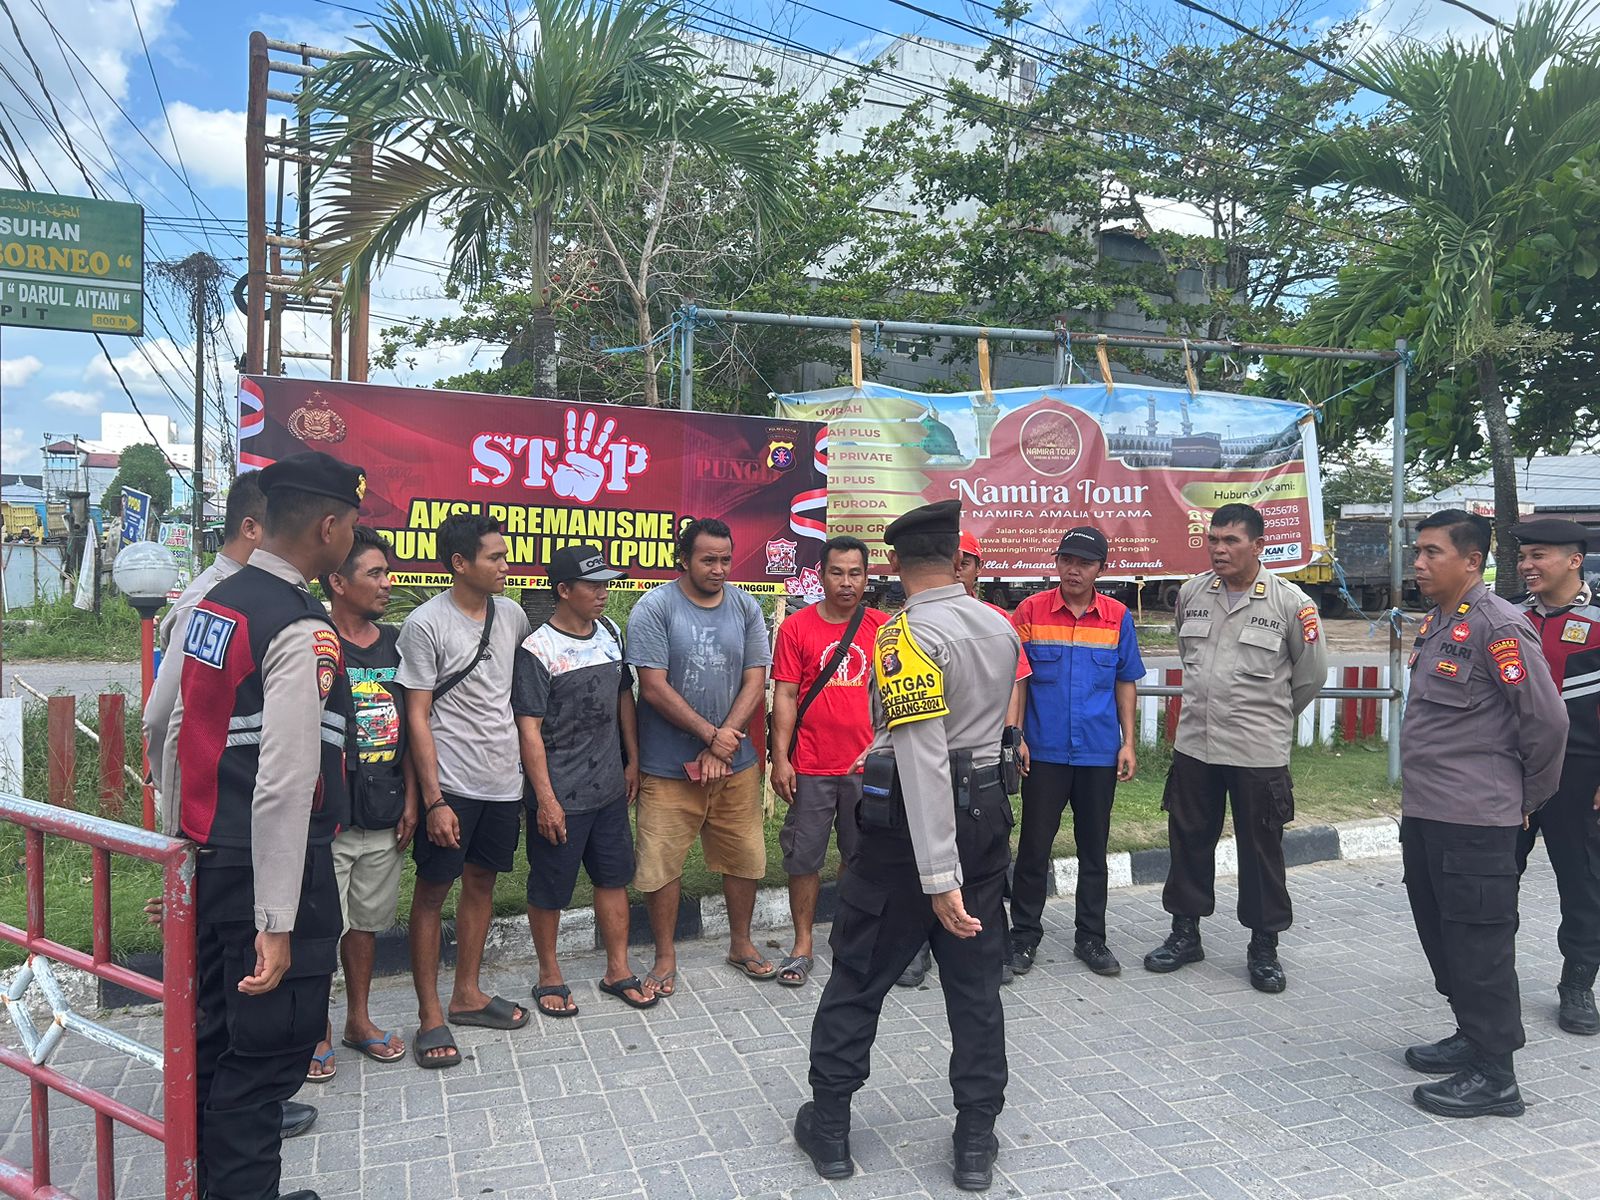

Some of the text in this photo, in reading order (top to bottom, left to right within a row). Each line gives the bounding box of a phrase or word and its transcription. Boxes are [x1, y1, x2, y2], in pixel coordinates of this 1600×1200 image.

[19, 283, 70, 306] DARUL
[75, 287, 120, 311] AITAM
[96, 315, 116, 326] 800
[850, 429, 880, 439] PLUS
[1026, 447, 1077, 456] NAMIRA TOUR
[841, 452, 893, 464] PRIVATE
[844, 475, 875, 485] PLUS
[950, 478, 1149, 507] Namira Tour
[1214, 480, 1296, 501] Hubungi Kami:
[834, 500, 887, 509] FURODA
[973, 510, 1035, 518] NAMIRA
[1039, 511, 1090, 519] AMALIA
[1094, 510, 1153, 519] UTAMA
[489, 505, 674, 540] PREMANISME
[828, 524, 863, 533] TOUR
[1019, 528, 1037, 536] Kopi
[1115, 537, 1159, 545] Ketapang,
[1029, 546, 1055, 554] Timur,
[1118, 546, 1149, 554] Tengah
[1265, 546, 1284, 556] KAN
[1119, 559, 1163, 569] Sunnah
[1251, 616, 1280, 630] POLRI
[1439, 642, 1473, 660] POLRI
[882, 674, 936, 699] SATGAS
